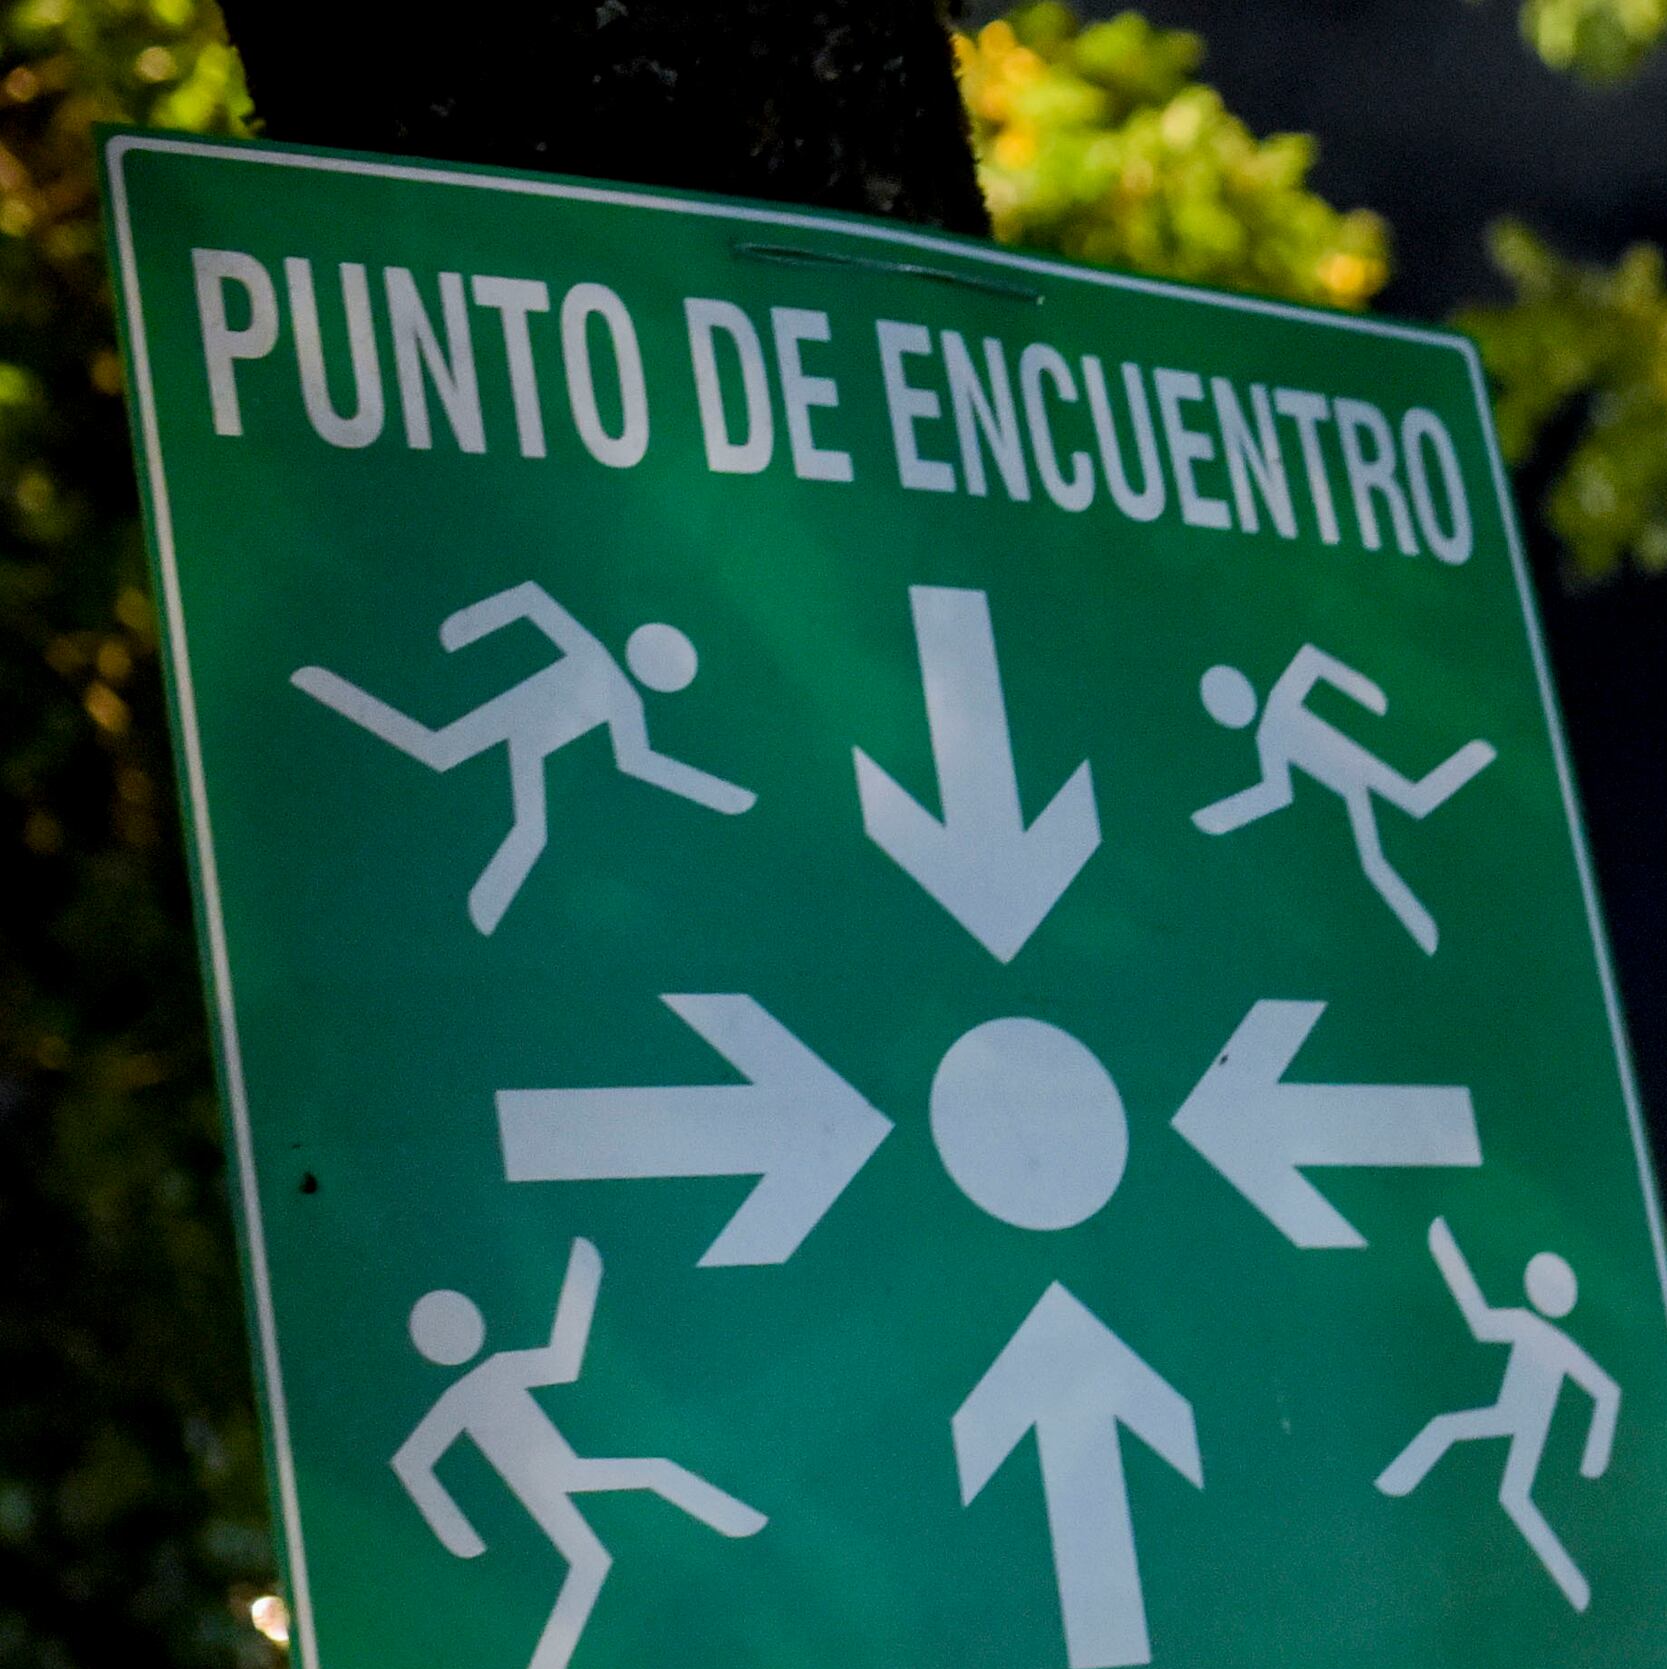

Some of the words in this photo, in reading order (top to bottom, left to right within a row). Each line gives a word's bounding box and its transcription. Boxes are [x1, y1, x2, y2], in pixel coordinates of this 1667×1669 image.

[192, 247, 650, 469] PUNTO
[686, 298, 855, 483] DE
[876, 319, 1475, 567] ENCUENTRO
